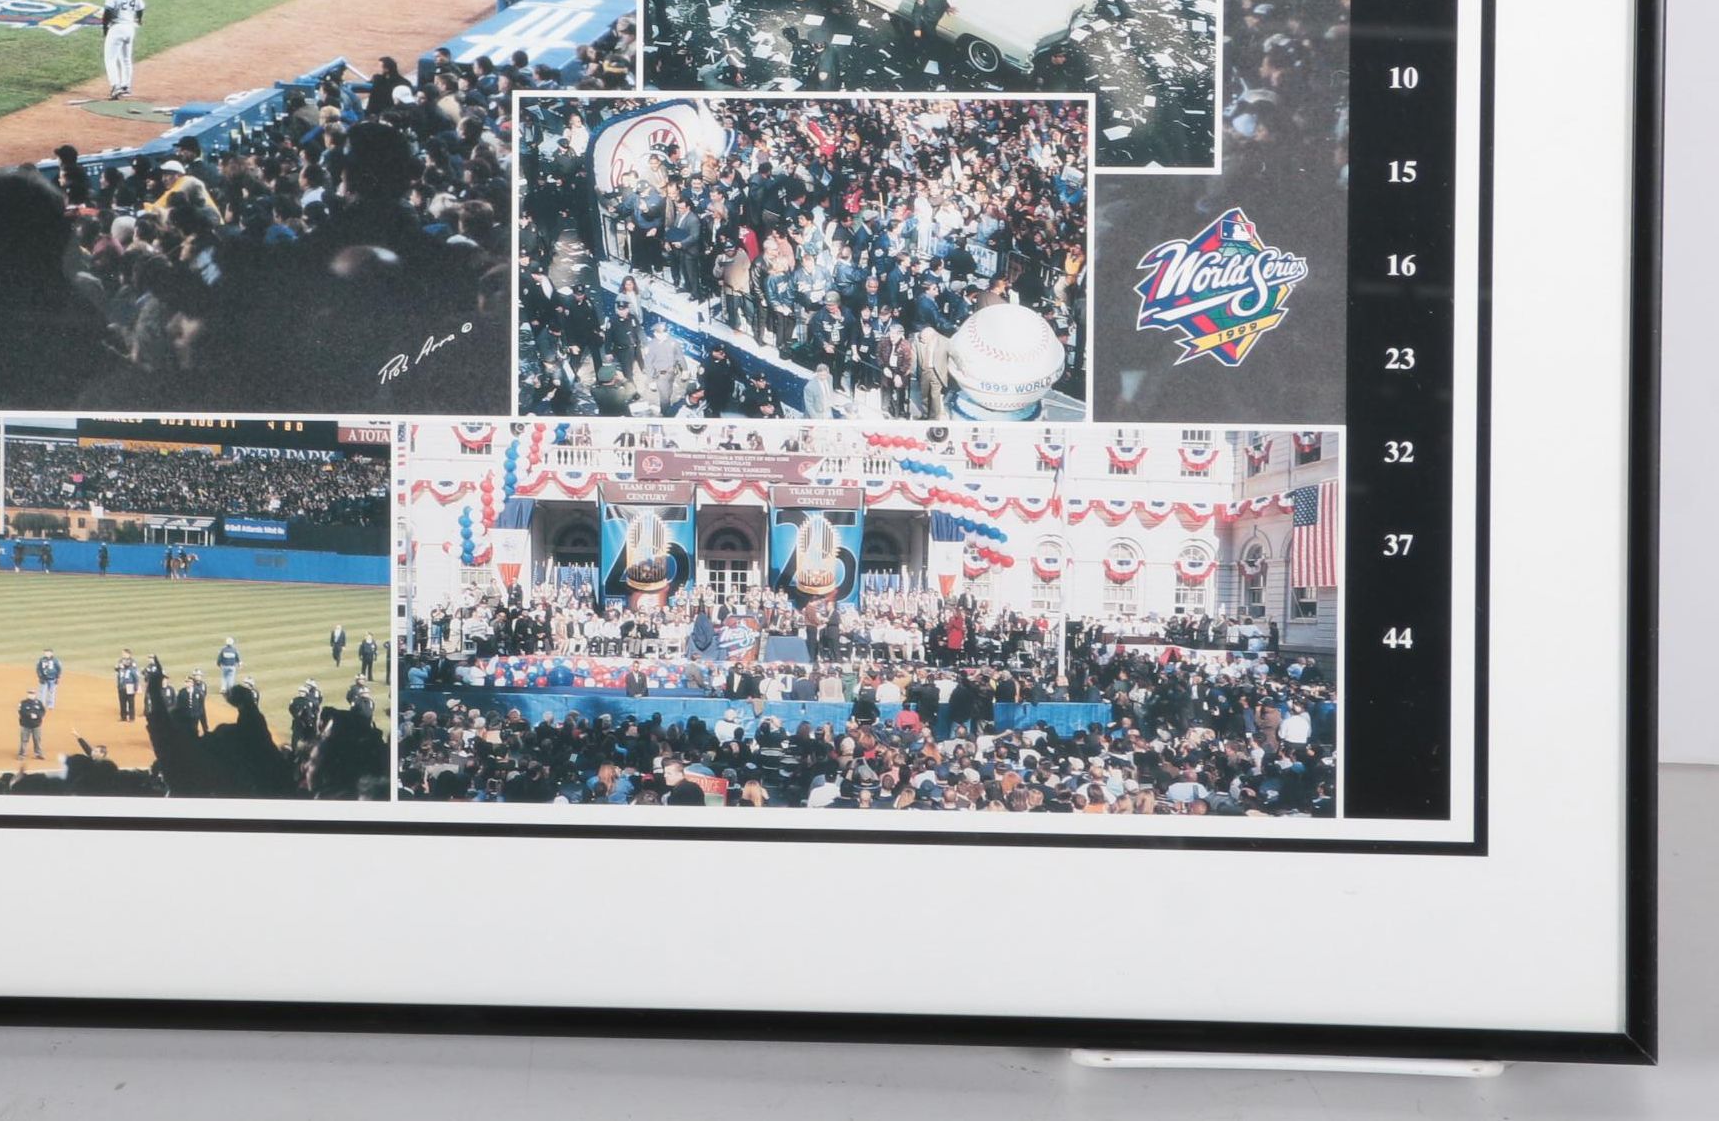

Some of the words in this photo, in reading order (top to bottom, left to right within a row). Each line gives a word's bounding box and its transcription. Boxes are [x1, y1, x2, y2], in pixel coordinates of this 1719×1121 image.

[1389, 66, 1419, 89] 10
[1388, 160, 1417, 183] 15
[1387, 254, 1416, 277] 16
[1137, 240, 1252, 300] World
[1232, 247, 1308, 317] Series
[1217, 322, 1258, 342] 1999
[1385, 347, 1415, 370] 23
[979, 381, 1009, 392] 1999
[1015, 377, 1052, 394] WORLD
[1384, 440, 1414, 463] 32
[619, 483, 644, 492] TEAM
[646, 483, 658, 492] OF
[659, 484, 675, 493] THE
[626, 493, 667, 502] CENTURY
[789, 487, 814, 496] TEAM
[816, 488, 827, 496] OF
[828, 488, 844, 496] THE
[797, 497, 837, 506] CENTURY
[1383, 533, 1414, 556] 37
[1382, 627, 1413, 649] 44
